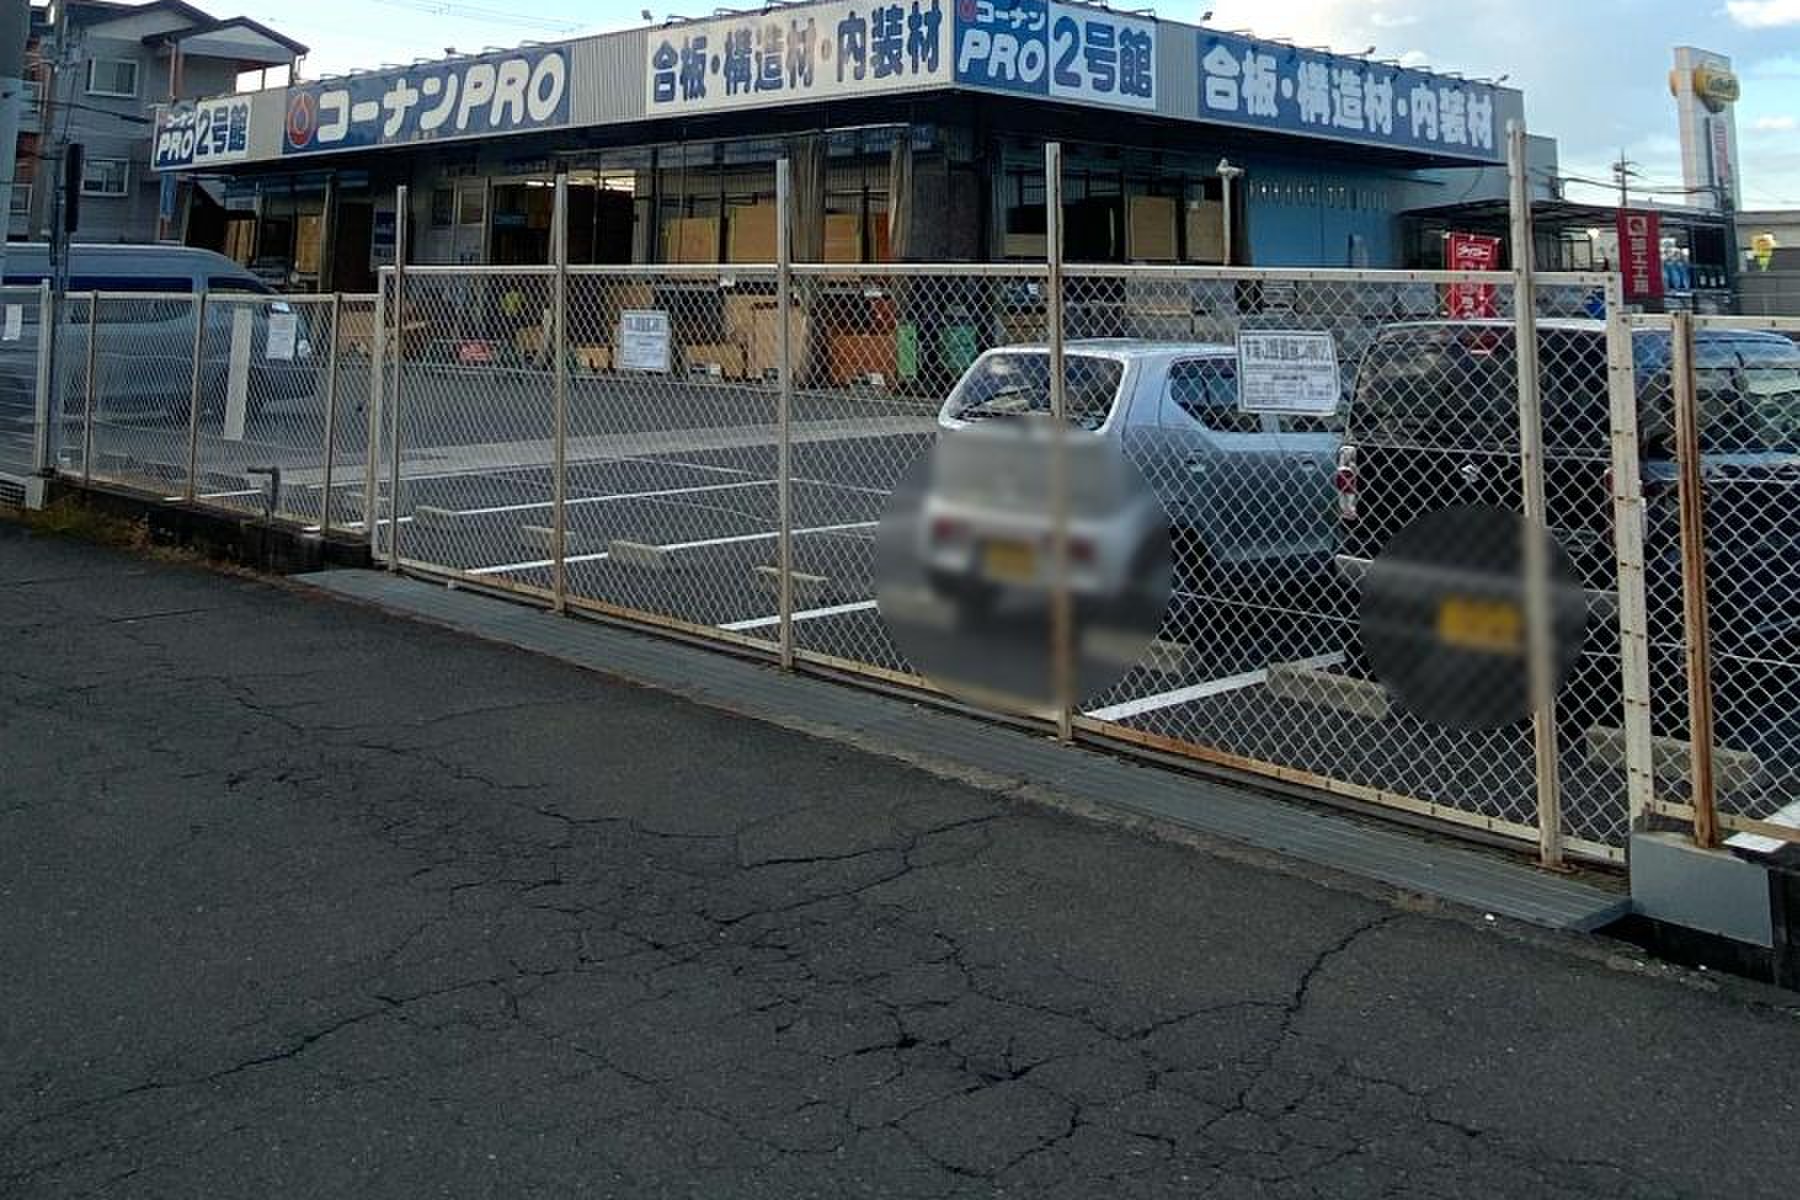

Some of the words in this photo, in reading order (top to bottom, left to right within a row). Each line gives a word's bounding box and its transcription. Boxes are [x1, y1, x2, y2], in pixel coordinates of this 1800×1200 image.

[976, 0, 1045, 31] コーナン
[959, 29, 1046, 82] PRO
[1054, 15, 1152, 98] 2号館
[157, 130, 193, 161] PRO
[196, 102, 249, 156] 2号館
